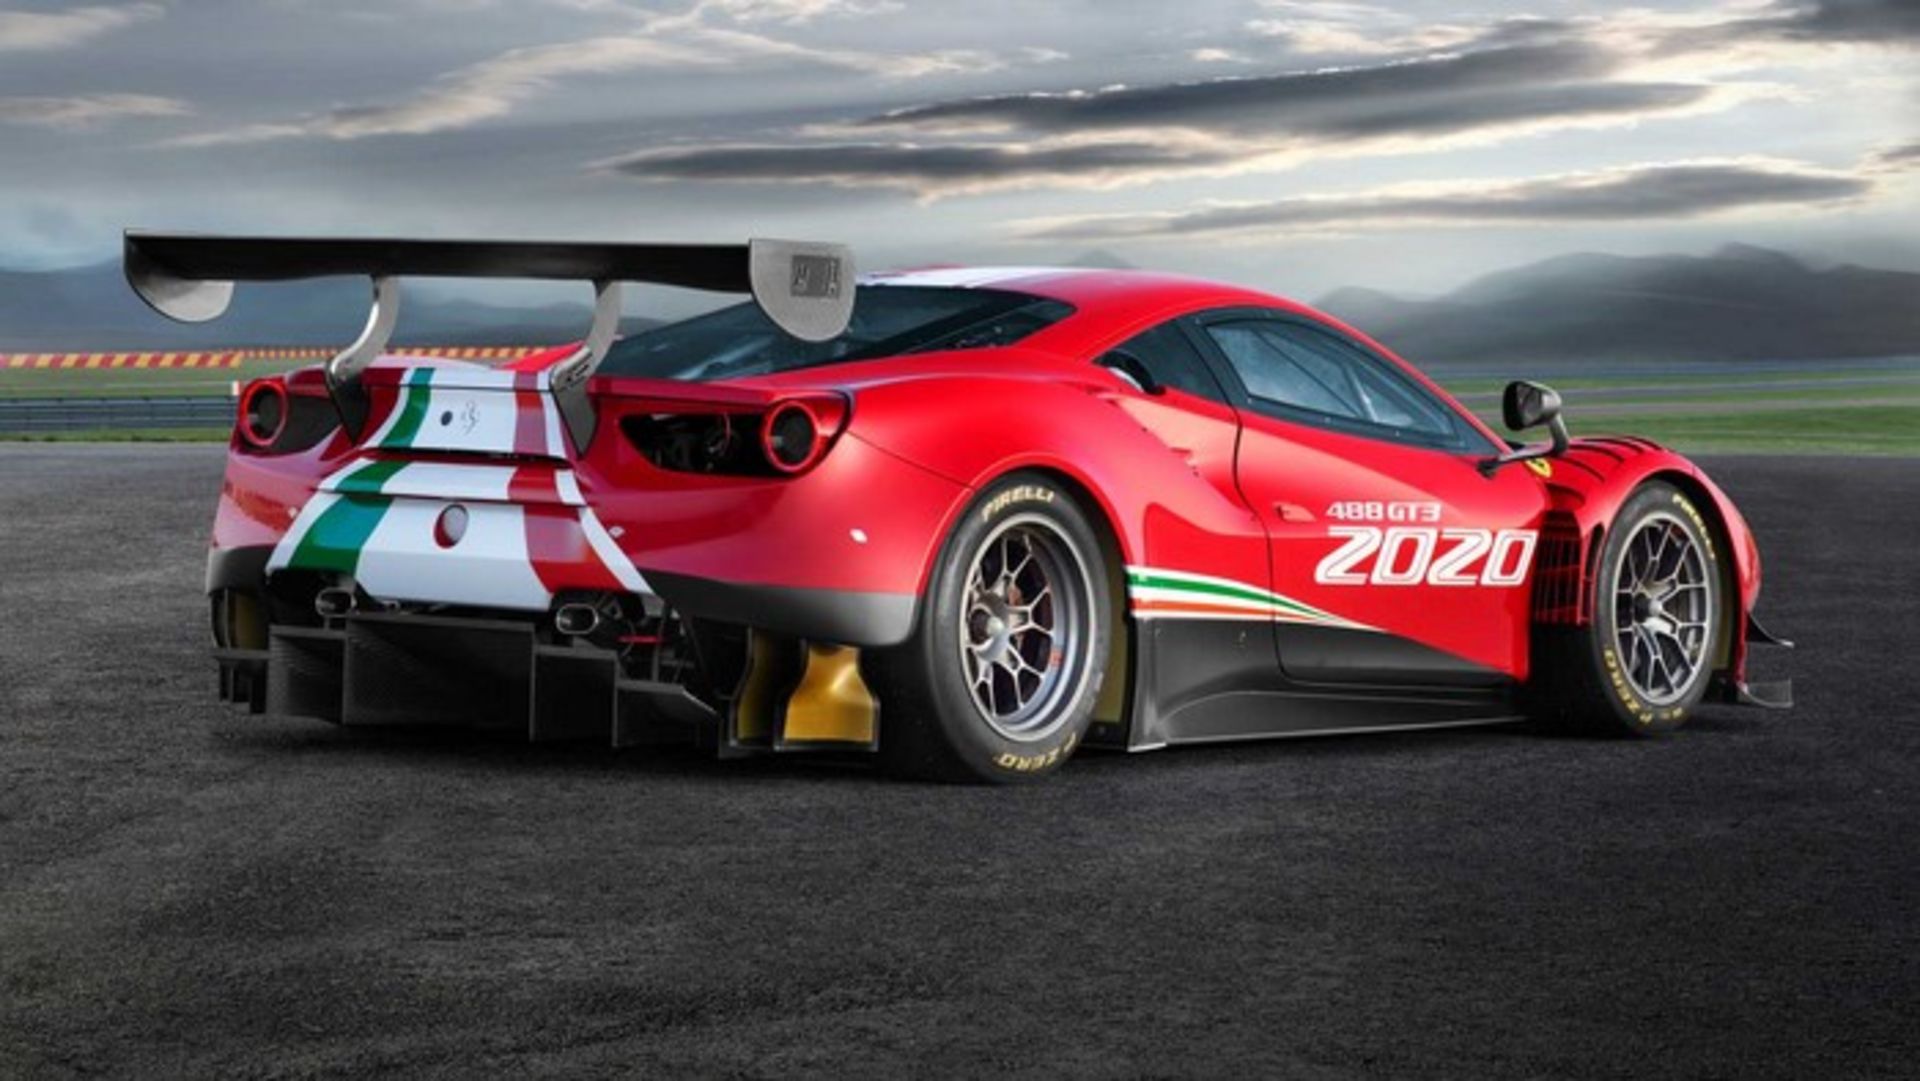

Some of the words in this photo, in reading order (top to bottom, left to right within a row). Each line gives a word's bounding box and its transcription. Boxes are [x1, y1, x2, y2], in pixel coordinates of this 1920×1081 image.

[982, 485, 1055, 523] PIRELLI
[1326, 501, 1383, 520] 488
[1387, 501, 1441, 521] GT3
[1314, 526, 1539, 586] 2020
